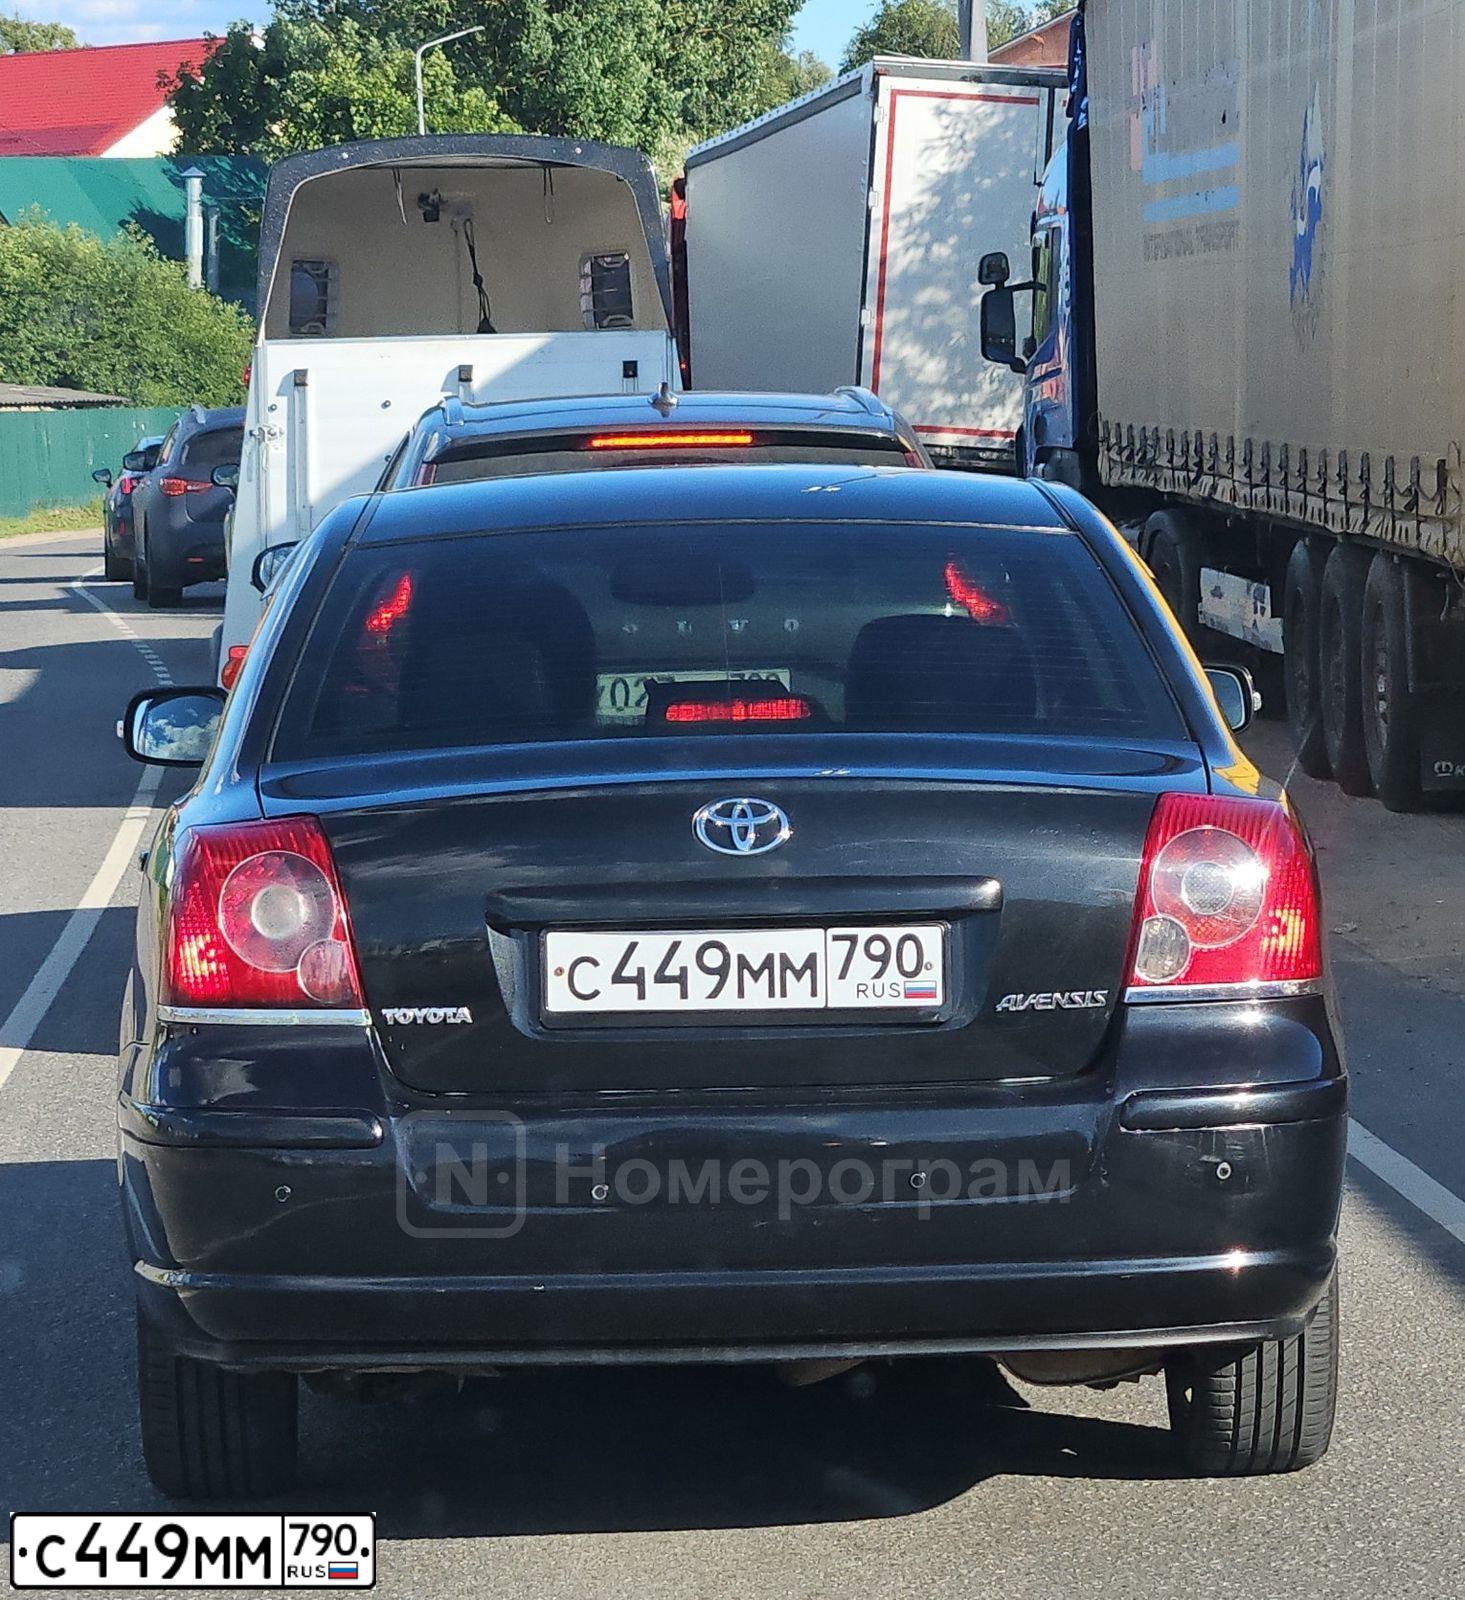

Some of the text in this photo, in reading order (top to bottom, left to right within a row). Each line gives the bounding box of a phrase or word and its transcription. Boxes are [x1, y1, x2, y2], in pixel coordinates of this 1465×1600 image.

[568, 933, 924, 1000] C449MM 790
[856, 982, 901, 998] RUS
[995, 990, 1109, 1012] AVENSIS
[381, 1006, 473, 1025] TOYOTA
